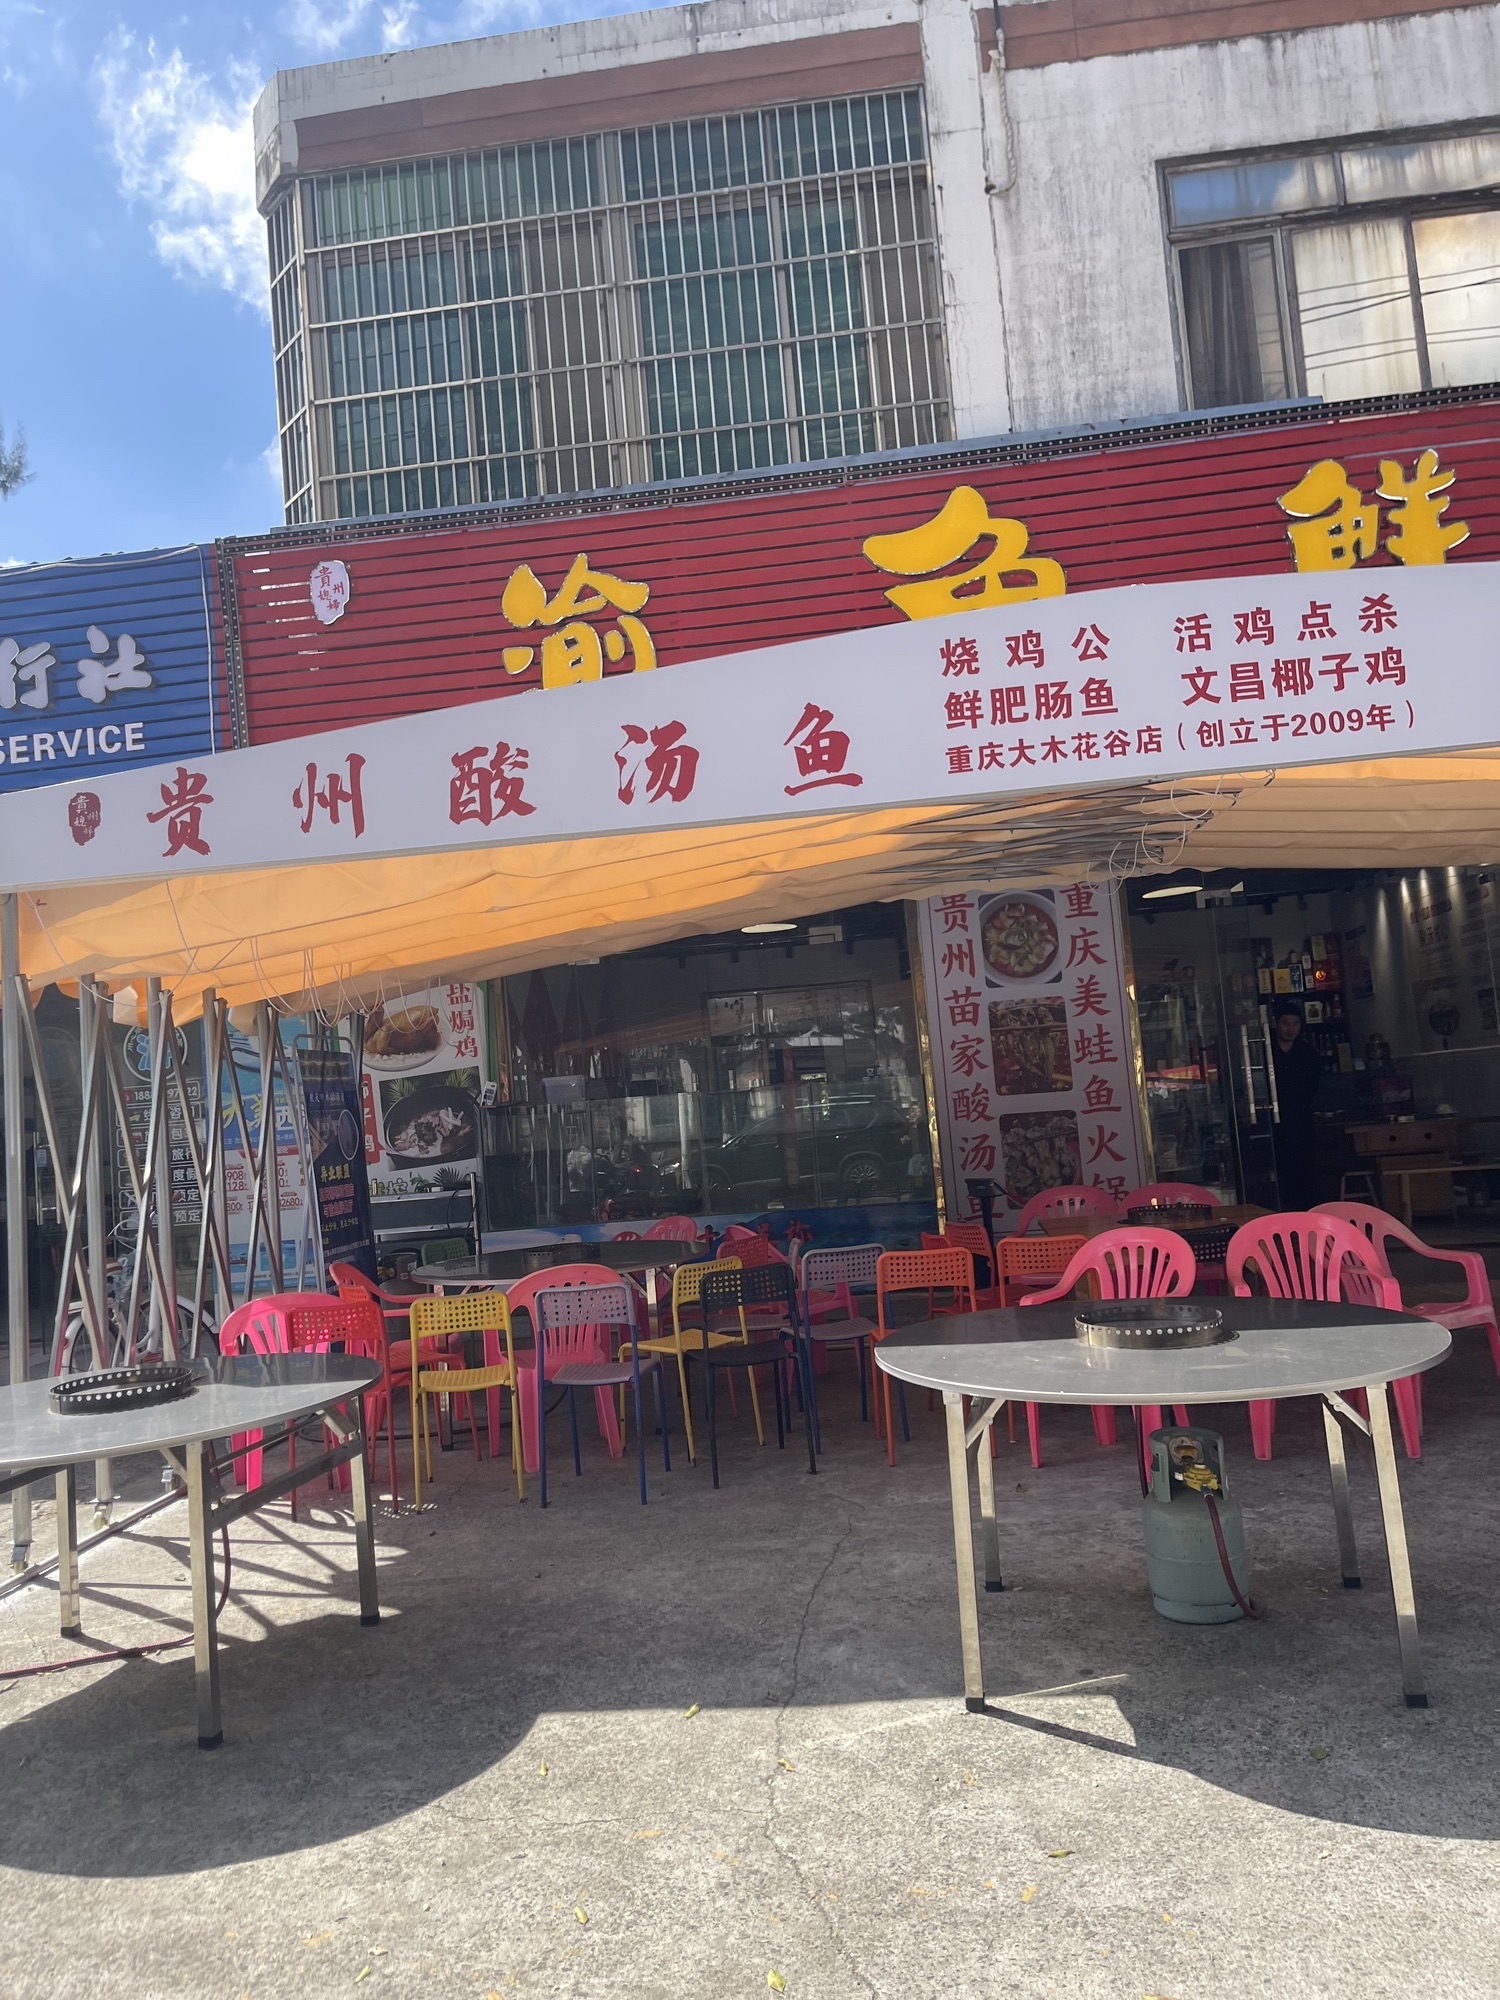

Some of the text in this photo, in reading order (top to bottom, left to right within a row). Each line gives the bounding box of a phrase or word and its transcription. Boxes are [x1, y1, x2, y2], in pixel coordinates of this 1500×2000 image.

[939, 593, 1398, 678] 烧鸡公 活鸡点杀
[944, 646, 1407, 731] 鲜肥肠鱼 文昌椰子鸡
[147, 703, 863, 857] 贵州酸汤鱼
[446, 983, 479, 1059] 盐焗鸡
